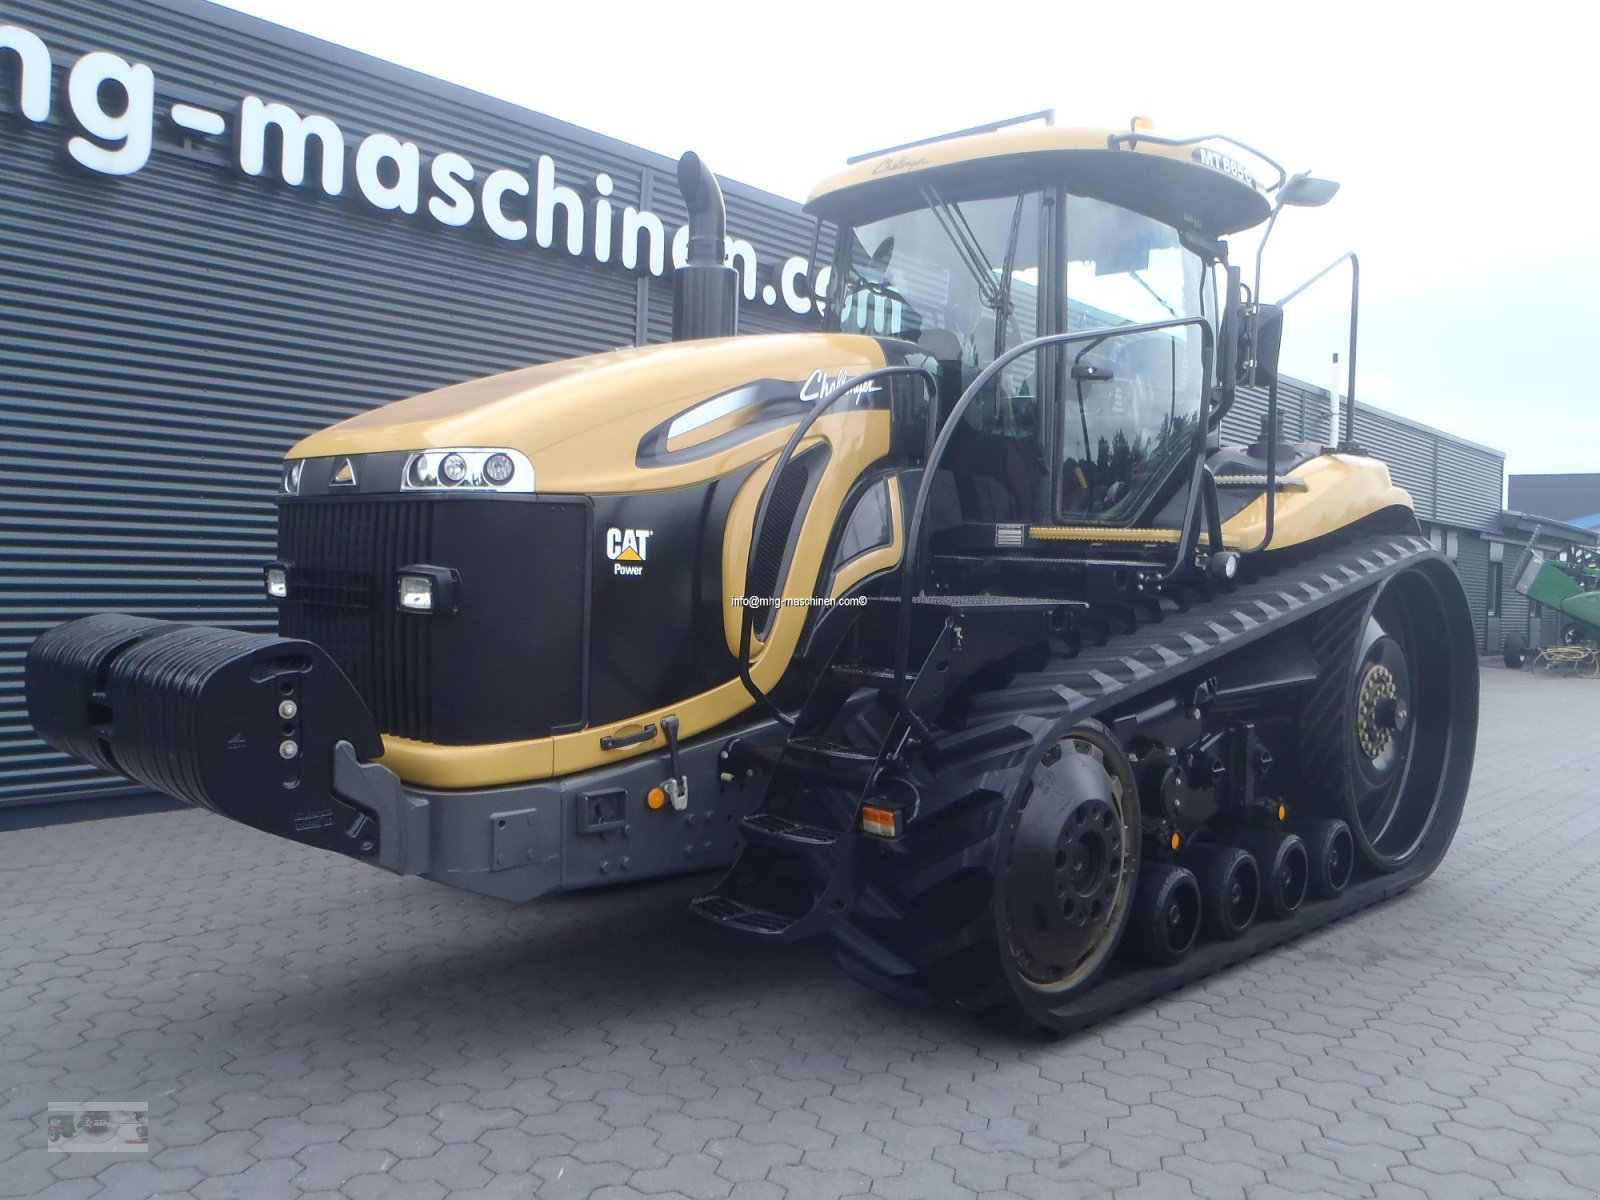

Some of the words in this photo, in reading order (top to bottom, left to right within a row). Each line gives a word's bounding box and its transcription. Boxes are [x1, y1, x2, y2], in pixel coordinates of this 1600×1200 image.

[800, 369, 882, 405] Challnger
[607, 527, 646, 560] CAT
[614, 563, 643, 575] Power
